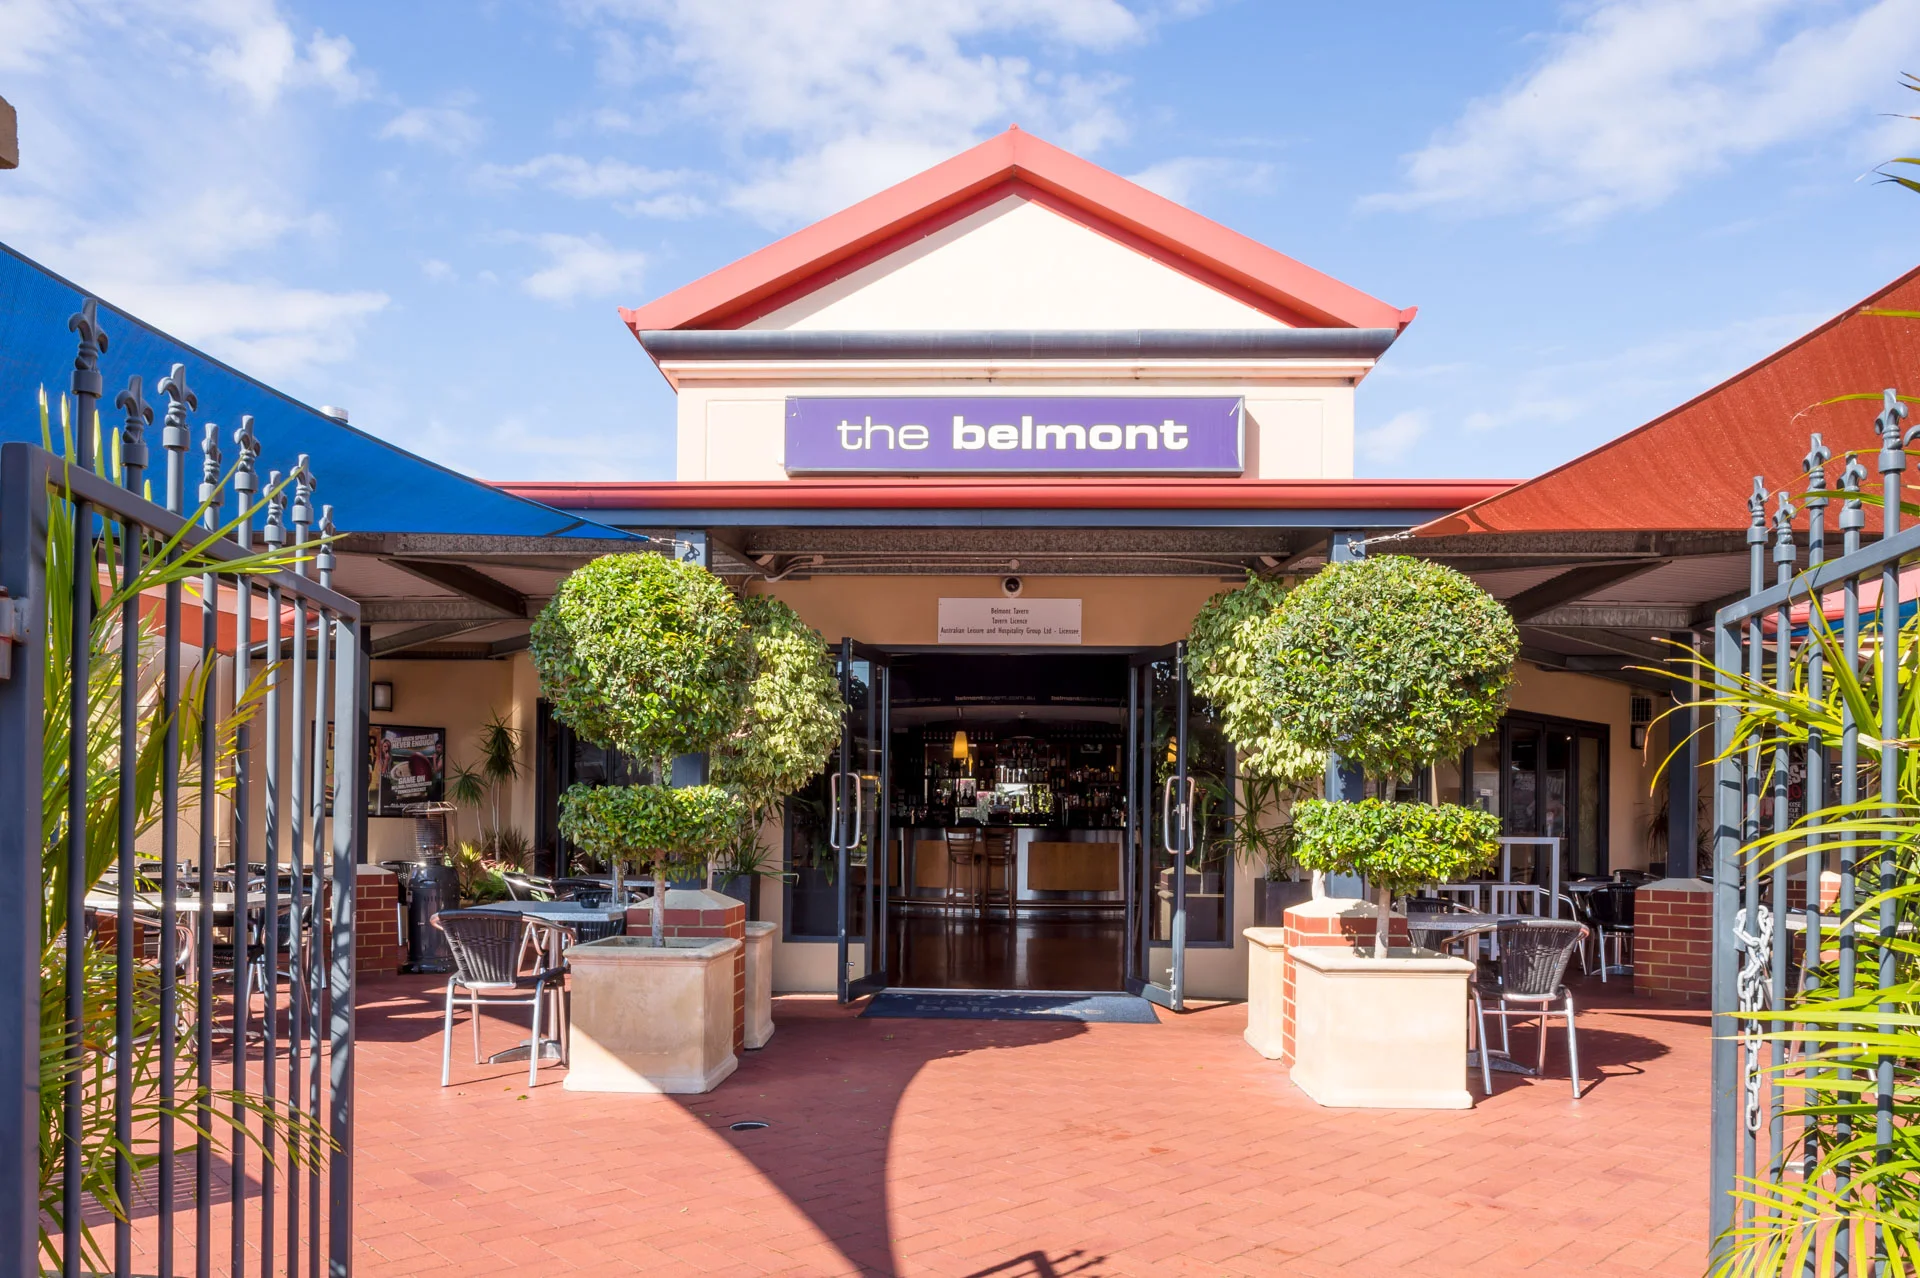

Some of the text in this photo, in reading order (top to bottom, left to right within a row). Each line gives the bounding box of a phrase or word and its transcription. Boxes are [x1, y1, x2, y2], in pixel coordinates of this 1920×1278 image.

[836, 415, 1189, 451] the belmont
[990, 607, 1029, 615] Belmont Tavern
[992, 617, 1028, 625] Tavern Licence
[998, 627, 1024, 636] Hospitality
[1026, 628, 1041, 636] Group
[1043, 627, 1052, 635] Ltd
[1058, 627, 1079, 635] Licensee
[398, 776, 416, 784] GAME
